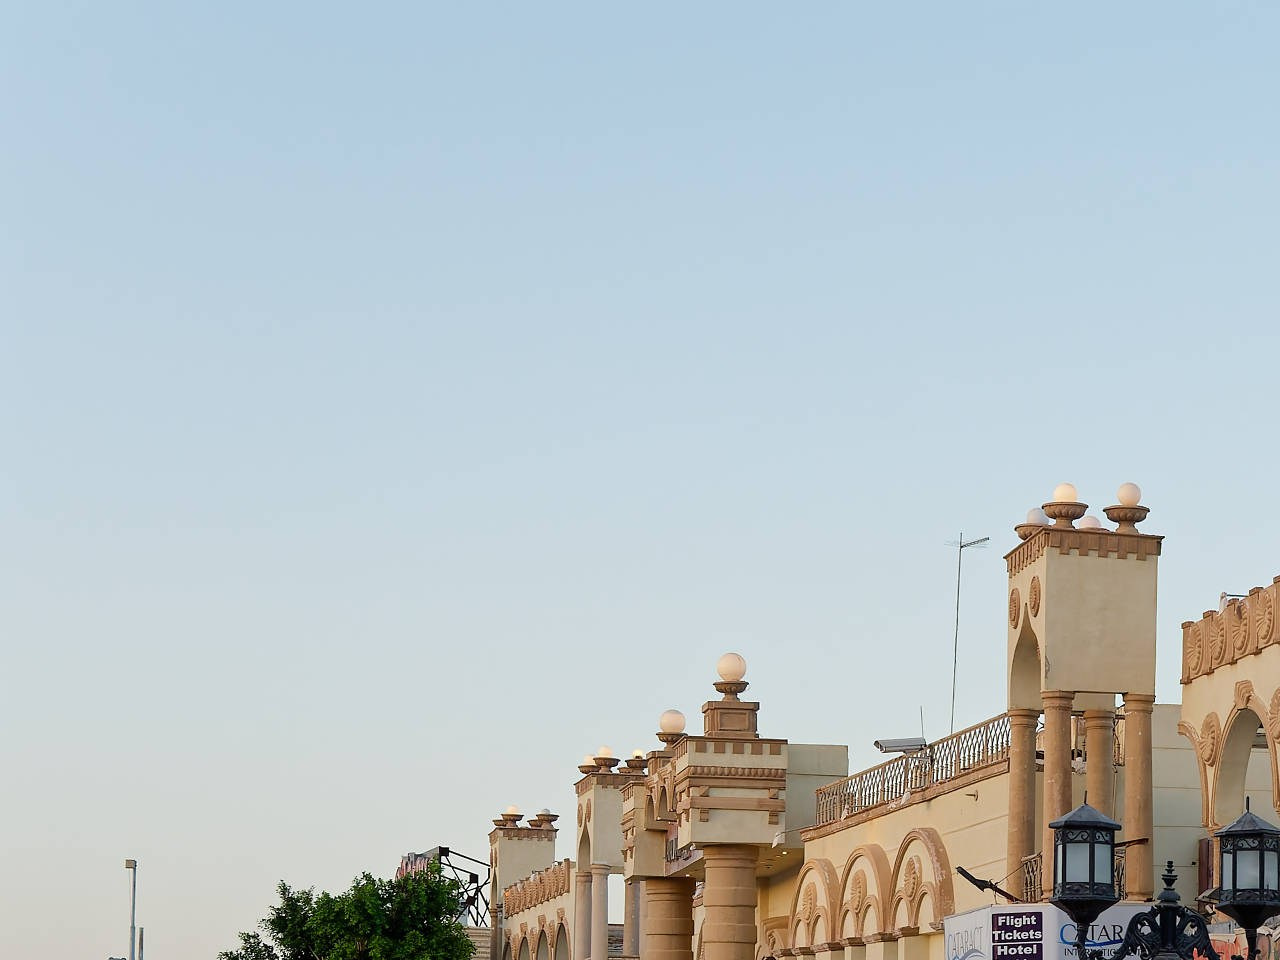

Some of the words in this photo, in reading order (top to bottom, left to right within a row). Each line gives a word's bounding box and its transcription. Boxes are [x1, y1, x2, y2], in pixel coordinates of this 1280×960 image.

[998, 915, 1037, 927] Flight
[993, 929, 1042, 941] Tickets
[997, 944, 1037, 956] Hotel
